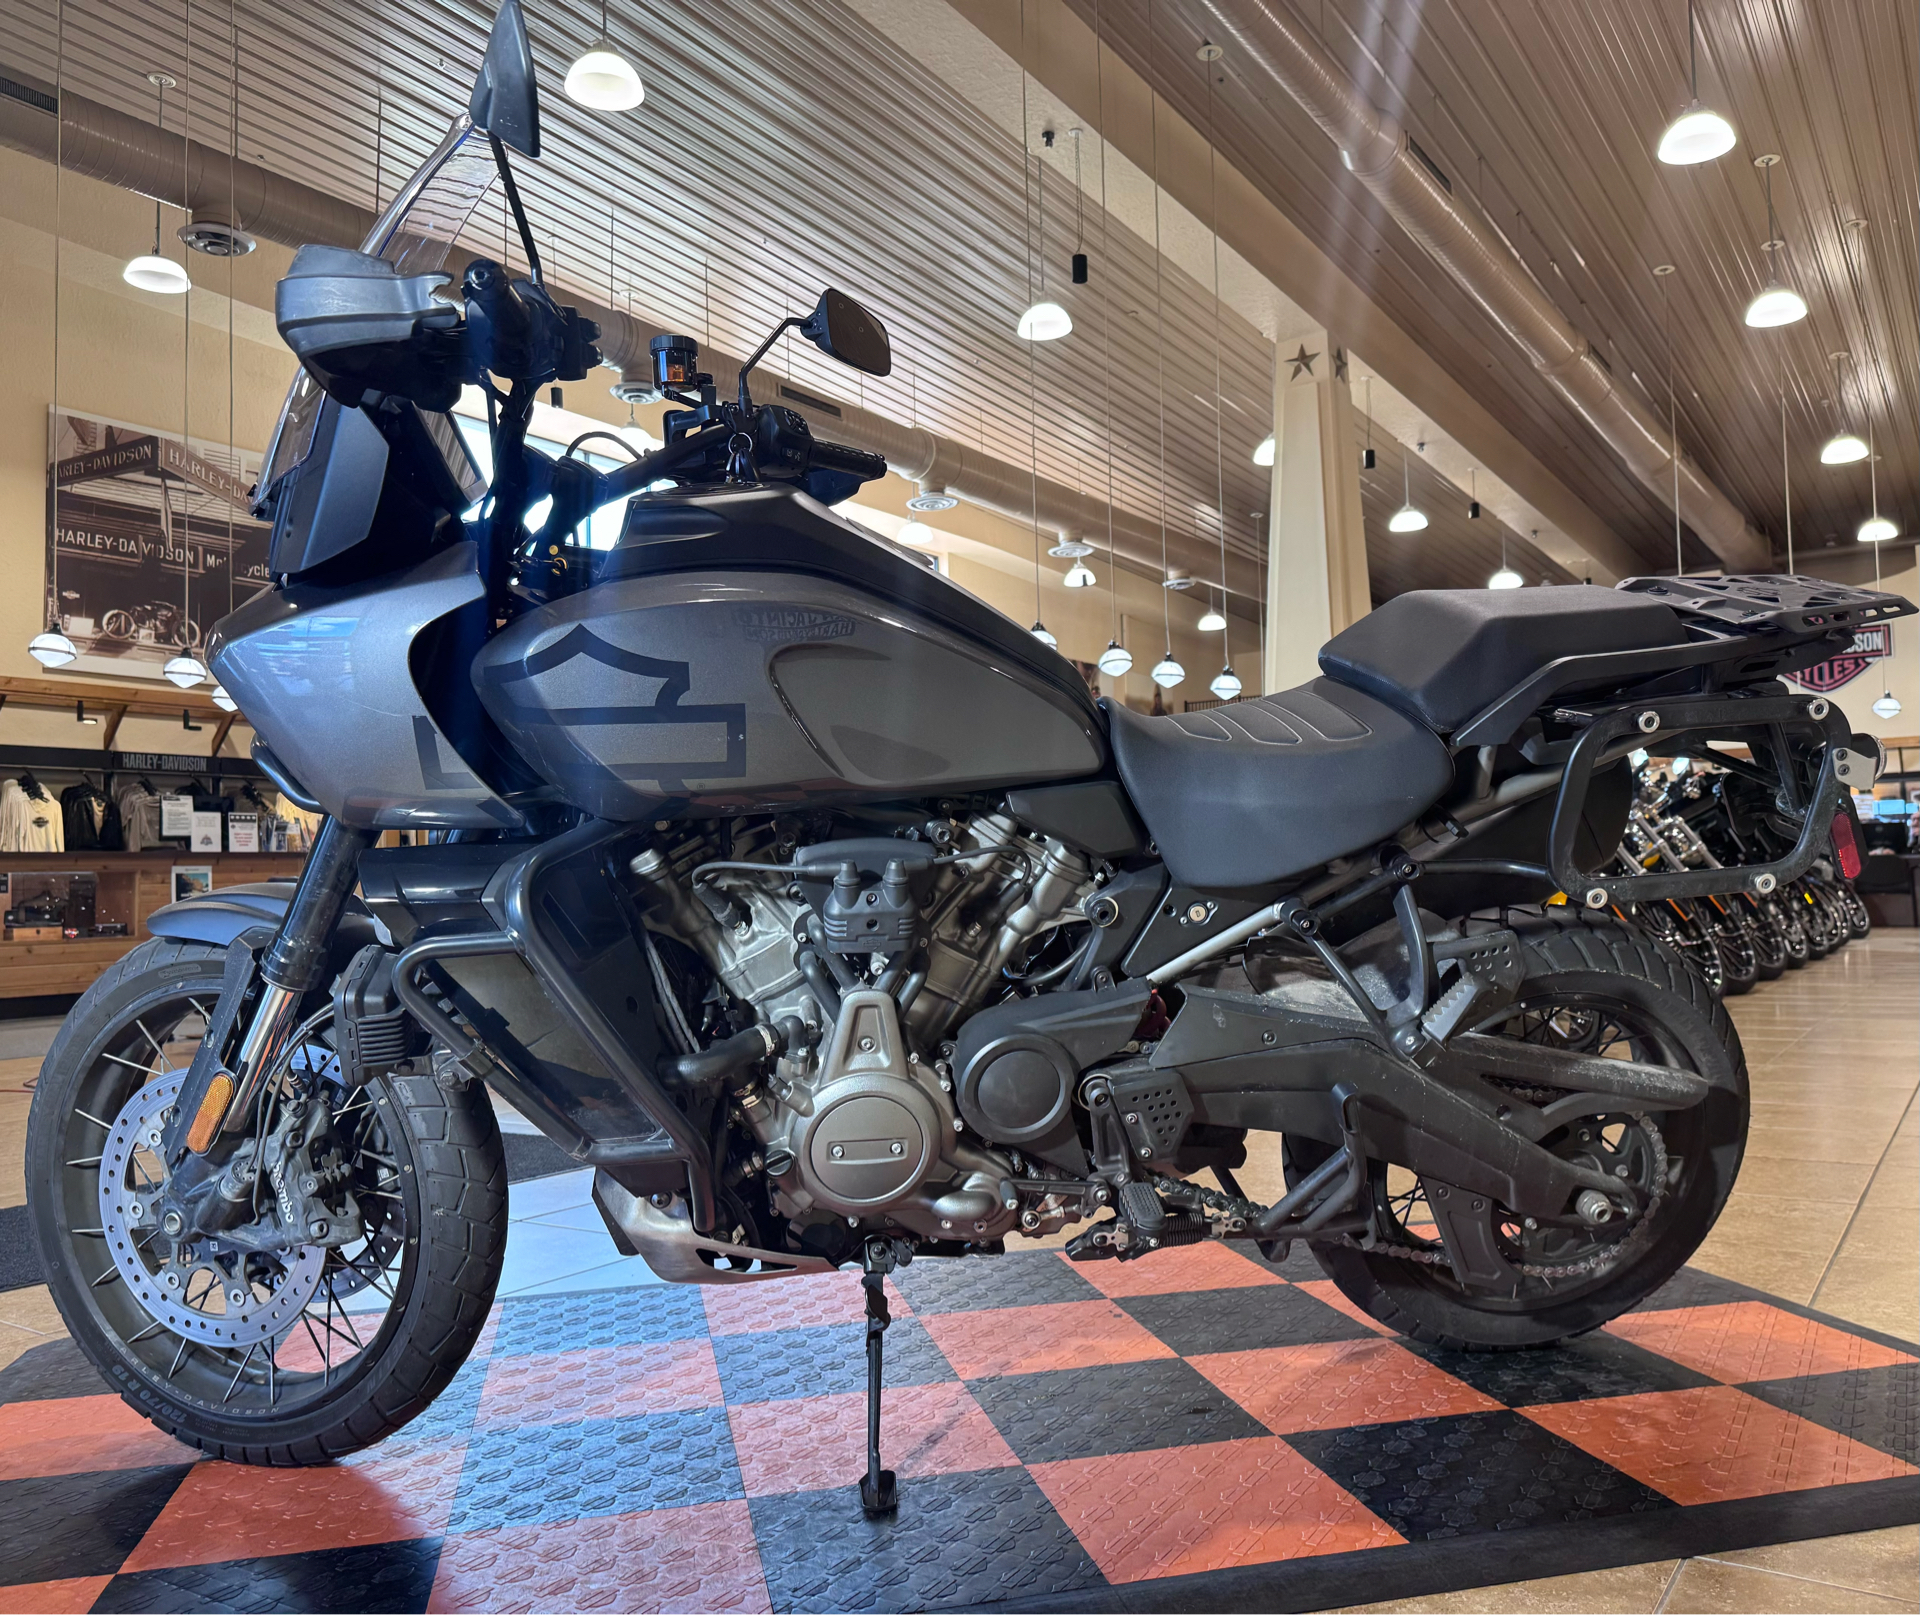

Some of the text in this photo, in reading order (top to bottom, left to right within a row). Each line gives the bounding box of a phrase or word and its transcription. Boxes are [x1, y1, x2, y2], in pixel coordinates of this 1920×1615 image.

[51, 444, 153, 479] ARLEY-DAVIDSON
[122, 753, 207, 772] HARLEY-DAVIDSON
[270, 1160, 294, 1224] brembo
[111, 1363, 188, 1423] 120/70 R 19
